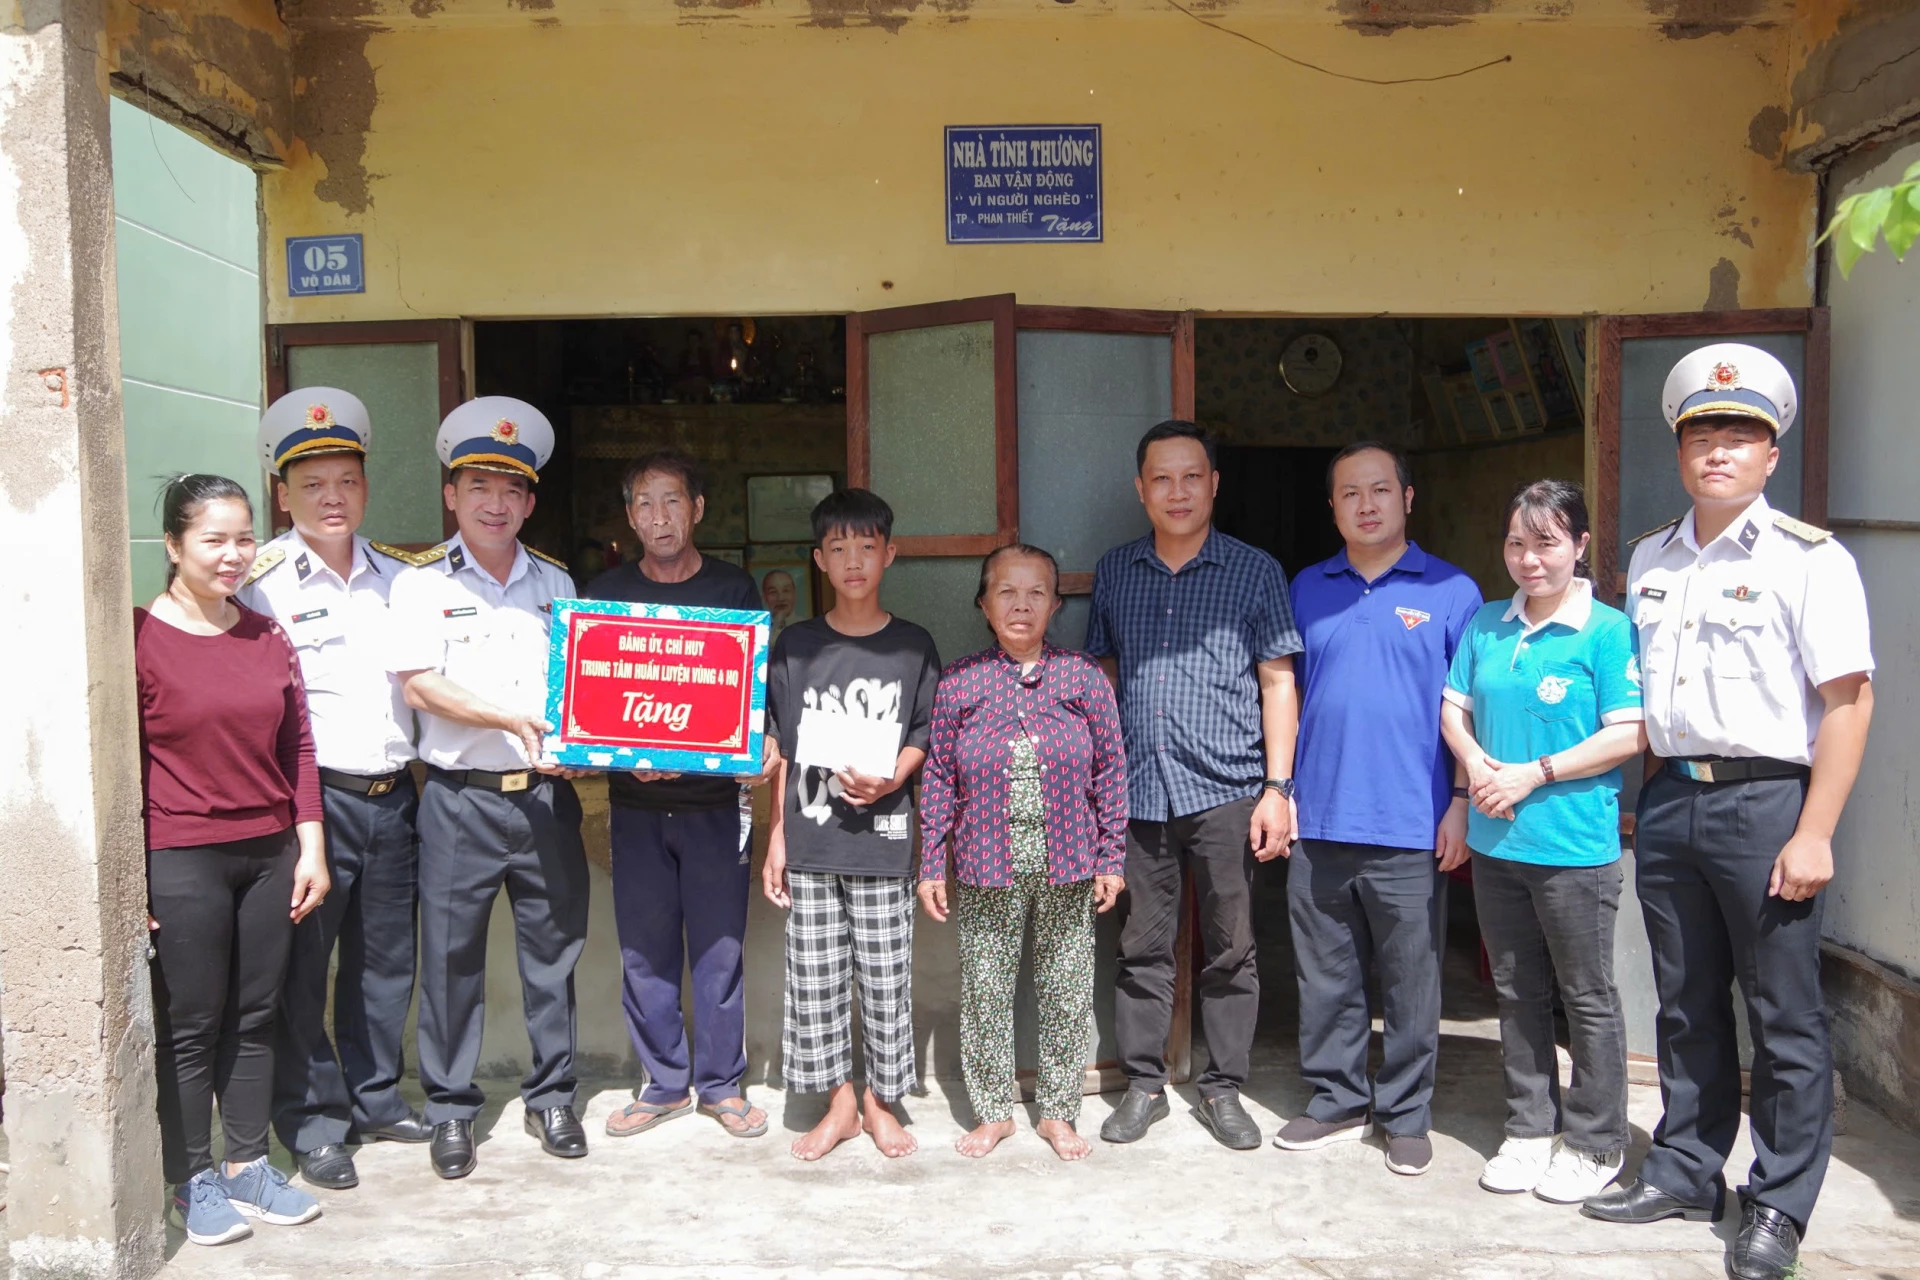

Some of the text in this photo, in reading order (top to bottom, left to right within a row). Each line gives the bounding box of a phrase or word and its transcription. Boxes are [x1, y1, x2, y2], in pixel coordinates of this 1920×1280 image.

[953, 133, 1094, 168] NHÀ TÌNH THƯƠNG
[974, 170, 1074, 190] BAN VẬN ĐỘNG
[968, 192, 982, 206] VÌ
[987, 192, 1028, 206] NGƯỜI
[1033, 192, 1081, 206] NGHÈO
[977, 212, 1003, 224] PHAN
[1006, 209, 1034, 224] THIẾT
[1041, 214, 1094, 236] Tặng
[304, 245, 348, 272] 05
[323, 272, 351, 287] DÂN
[618, 631, 647, 653] ĐẢNG
[665, 634, 684, 655] CHỈ
[684, 640, 705, 656] HUY
[580, 658, 739, 688] TRUNG TÂM HUẤN LUYỆN VÙNG 4 HQ
[622, 690, 693, 732] Tặng
